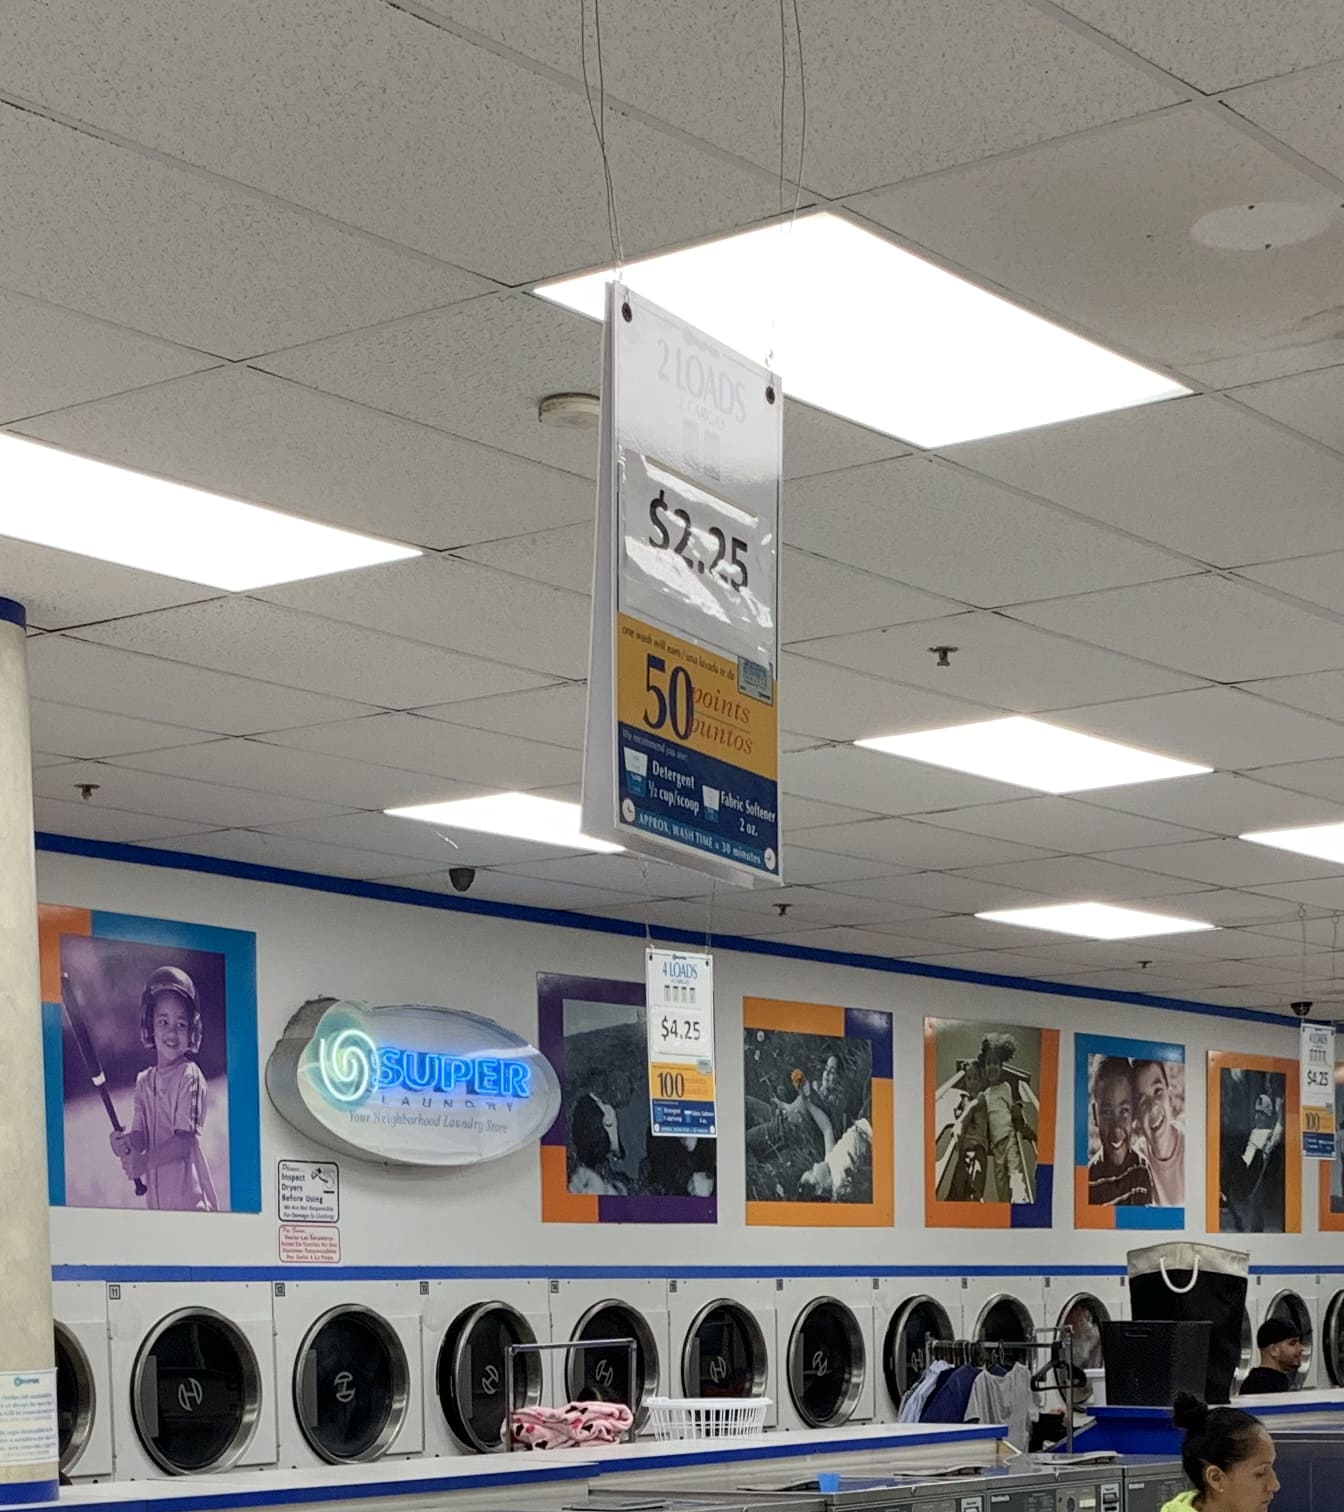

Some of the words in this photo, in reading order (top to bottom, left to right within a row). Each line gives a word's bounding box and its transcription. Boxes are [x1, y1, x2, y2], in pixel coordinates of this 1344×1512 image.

[658, 339, 670, 383] 2
[675, 349, 746, 424] LOADS
[649, 489, 749, 593] $2.25
[643, 652, 695, 741] 50
[692, 682, 751, 726] points
[652, 759, 696, 791] Detergent
[659, 787, 700, 817] cup/scoop
[721, 790, 744, 813] Fabric
[745, 797, 777, 824] Softener
[739, 817, 747, 832] 2
[639, 812, 670, 834] APPROX.
[672, 823, 694, 842] WASH
[695, 830, 714, 849] TIME
[721, 838, 732, 854] 30
[733, 842, 762, 866] minutes
[669, 961, 698, 980] LOADS
[661, 1015, 702, 1042] $4.25
[372, 1047, 531, 1099] SUPER
[657, 1071, 686, 1098] 100
[380, 1094, 515, 1112] LAUNDRY
[348, 1110, 371, 1124] Your
[373, 1111, 442, 1132] Neighborhood
[442, 1114, 485, 1134] Laundry
[485, 1118, 510, 1134] Store
[281, 1173, 306, 1183] Inspect
[281, 1183, 304, 1192] Dryers
[281, 1194, 304, 1202] Before
[305, 1195, 324, 1205] Using
